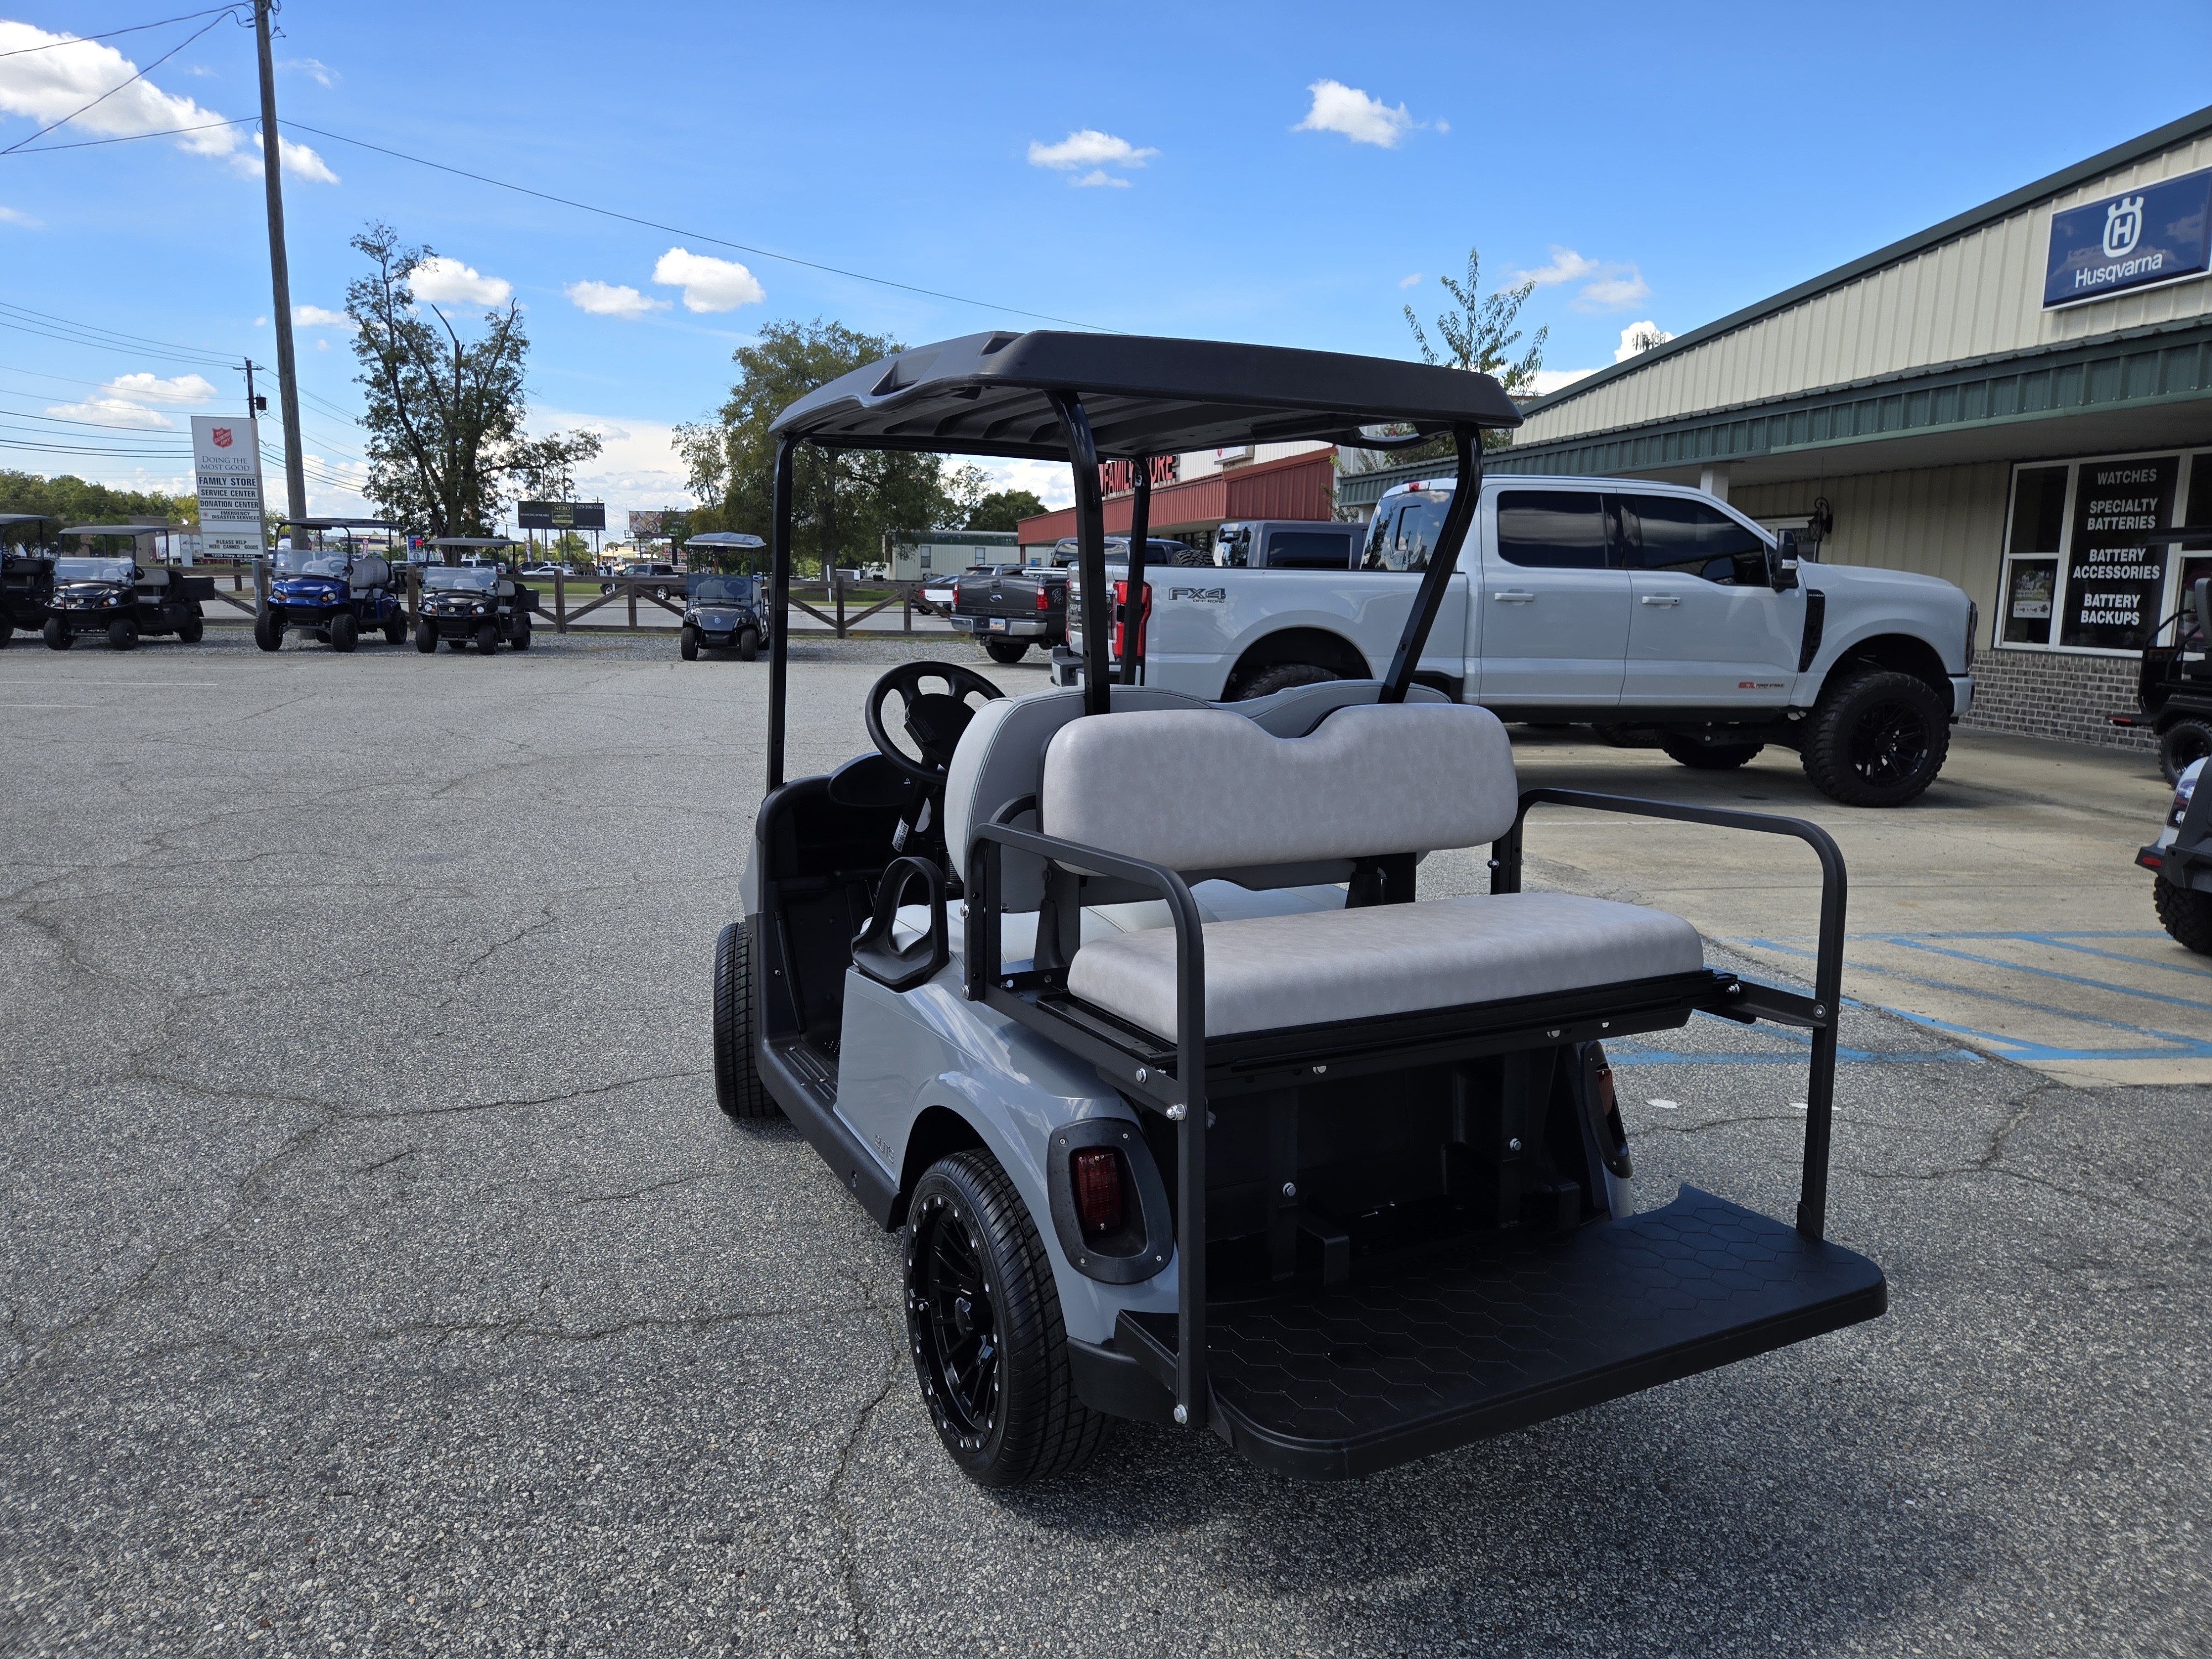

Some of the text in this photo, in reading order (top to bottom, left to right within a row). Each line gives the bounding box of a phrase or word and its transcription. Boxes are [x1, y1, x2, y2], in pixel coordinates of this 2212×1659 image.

[2075, 253, 2162, 288] Husqvarna
[202, 456, 231, 464] DOING
[199, 477, 257, 487] FAMILY STORE
[1104, 460, 1134, 497] FAMILY
[2098, 469, 2157, 485] WATCHES
[2089, 497, 2158, 514] SPECIALTY
[2087, 515, 2156, 531] BATTERIES
[2089, 547, 2146, 562] BATTERY
[2073, 565, 2161, 580] ACCESSORIES
[1168, 587, 1226, 601] FX4
[2084, 593, 2141, 608] BATTERY
[2080, 610, 2140, 626] BACKUPS
